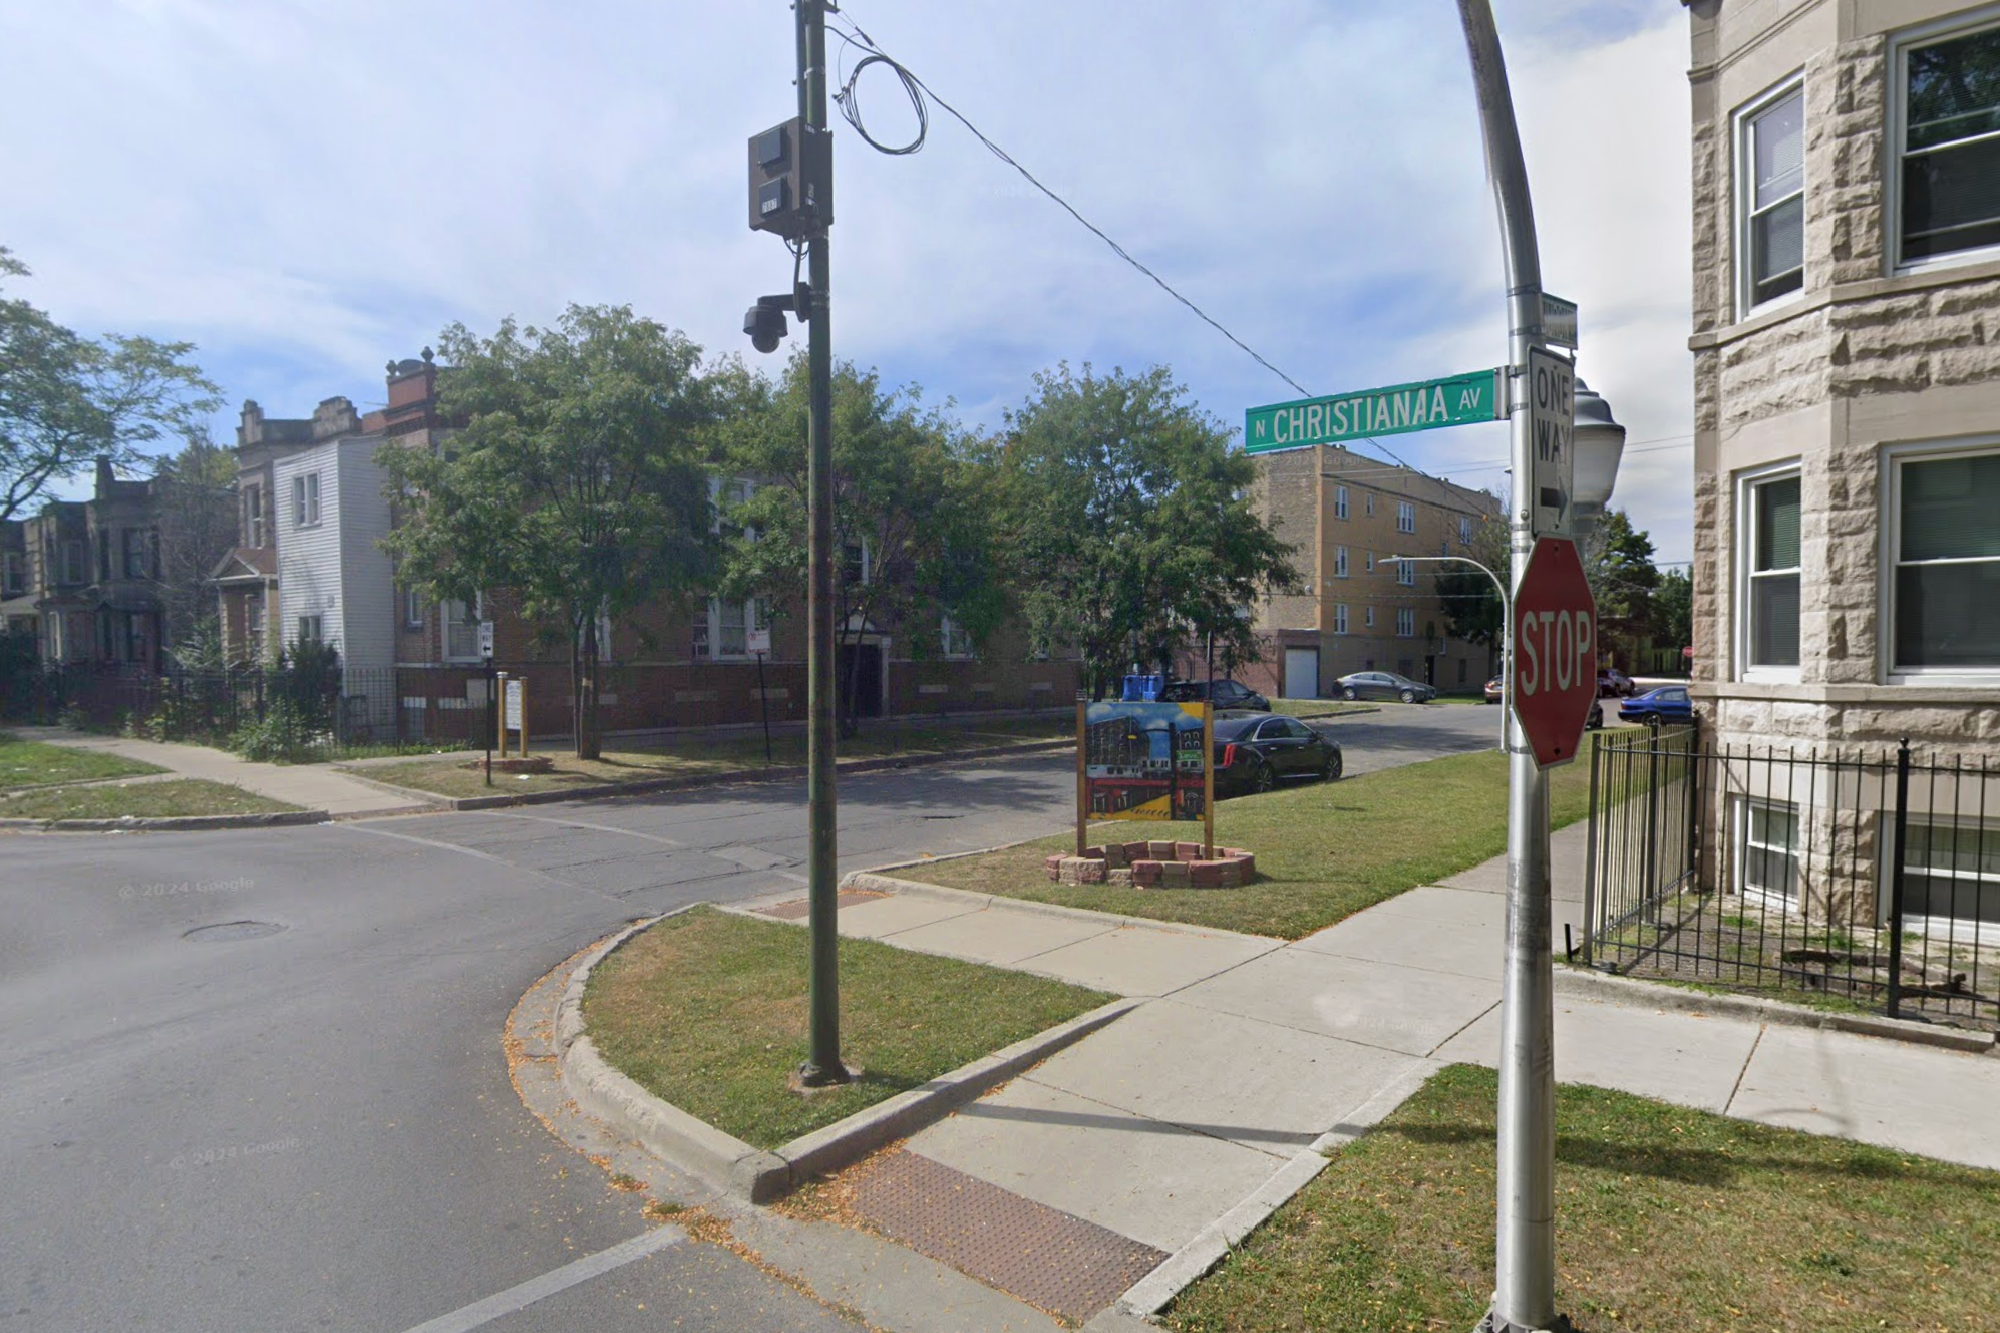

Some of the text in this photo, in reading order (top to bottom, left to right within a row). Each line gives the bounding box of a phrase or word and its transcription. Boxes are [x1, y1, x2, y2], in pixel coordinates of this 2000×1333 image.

[1256, 419, 1266, 438] N
[1459, 387, 1481, 410] AV
[1538, 366, 1569, 416] ONE
[1538, 418, 1570, 465] WAY
[1521, 609, 1591, 696] STOP
